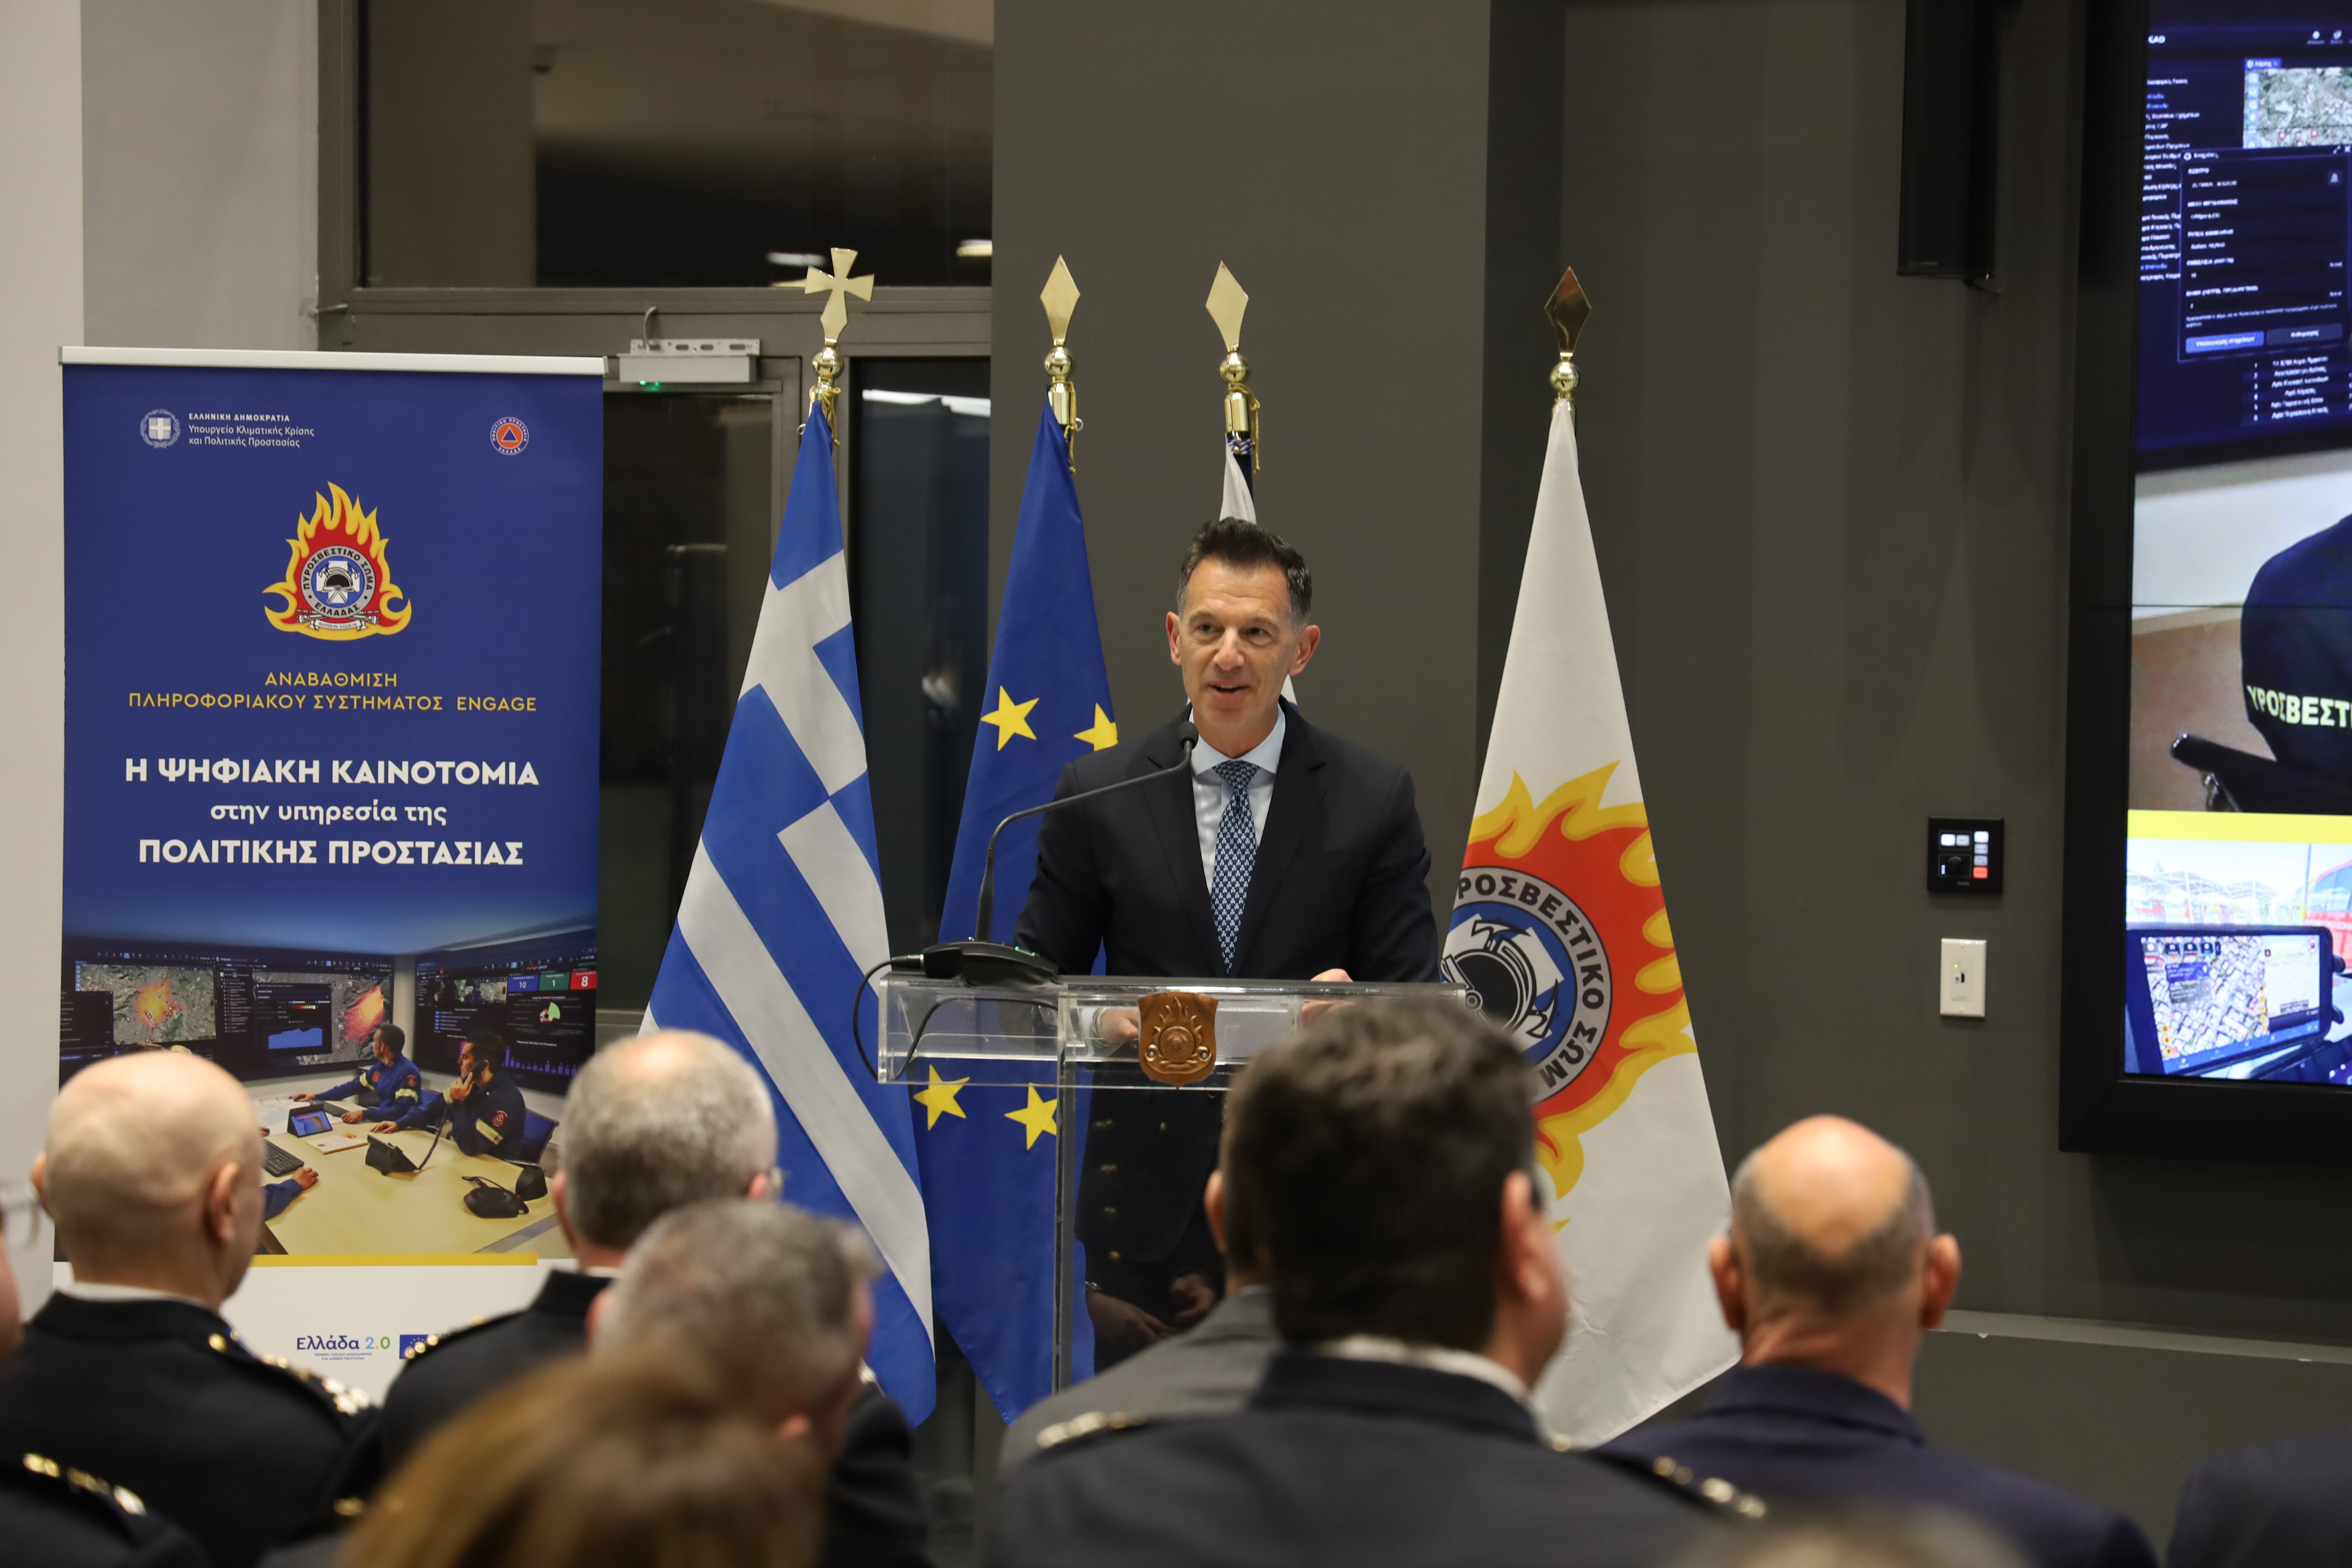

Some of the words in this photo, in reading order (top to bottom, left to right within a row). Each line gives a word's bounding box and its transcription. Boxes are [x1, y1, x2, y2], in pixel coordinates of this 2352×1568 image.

[189, 424, 234, 435] Υπουργείο
[236, 425, 283, 436] Κλιματικής
[285, 426, 314, 437] Κρίσης
[205, 436, 246, 447] Πολιτικής
[248, 437, 300, 448] Προστασίας
[303, 547, 361, 590] ΠΥΡΟΣΒΕΣΤΙΚΟ
[360, 561, 374, 590] ΣΩΜΑ
[314, 602, 360, 616] ΕΛΛΑΔΑΣ
[265, 672, 397, 687] ΑΝΑΒΑΘΜΙΣΗ
[129, 692, 306, 709] ΠΛΗΡΟΦΟΡΙΑΚΟΥ
[313, 695, 443, 710] ΣΥΣΤΗΜΑΤΟΣ
[457, 696, 537, 712] ENGAGE
[2246, 684, 2352, 728] ΥΡΟΣΒΕΣΤ
[126, 758, 147, 782] Η
[158, 758, 320, 784] ΨΗΦΙΑΚΗ
[332, 760, 539, 786] ΚΑΙΝΟΤΟΜΙΑ
[210, 804, 270, 825] στην
[278, 798, 398, 825] υπηρεσία
[404, 805, 447, 826] της
[139, 839, 317, 864] ΠΟΛΙΤΙΚΗΣ
[328, 840, 523, 866] ΠΡΟΣΤΑΣΙΑΣ
[581, 975, 589, 987] 8
[1538, 1020, 1598, 1088] ΣΩΜ
[297, 1335, 360, 1350] Ελλάδα
[365, 1336, 391, 1350] 2.0
